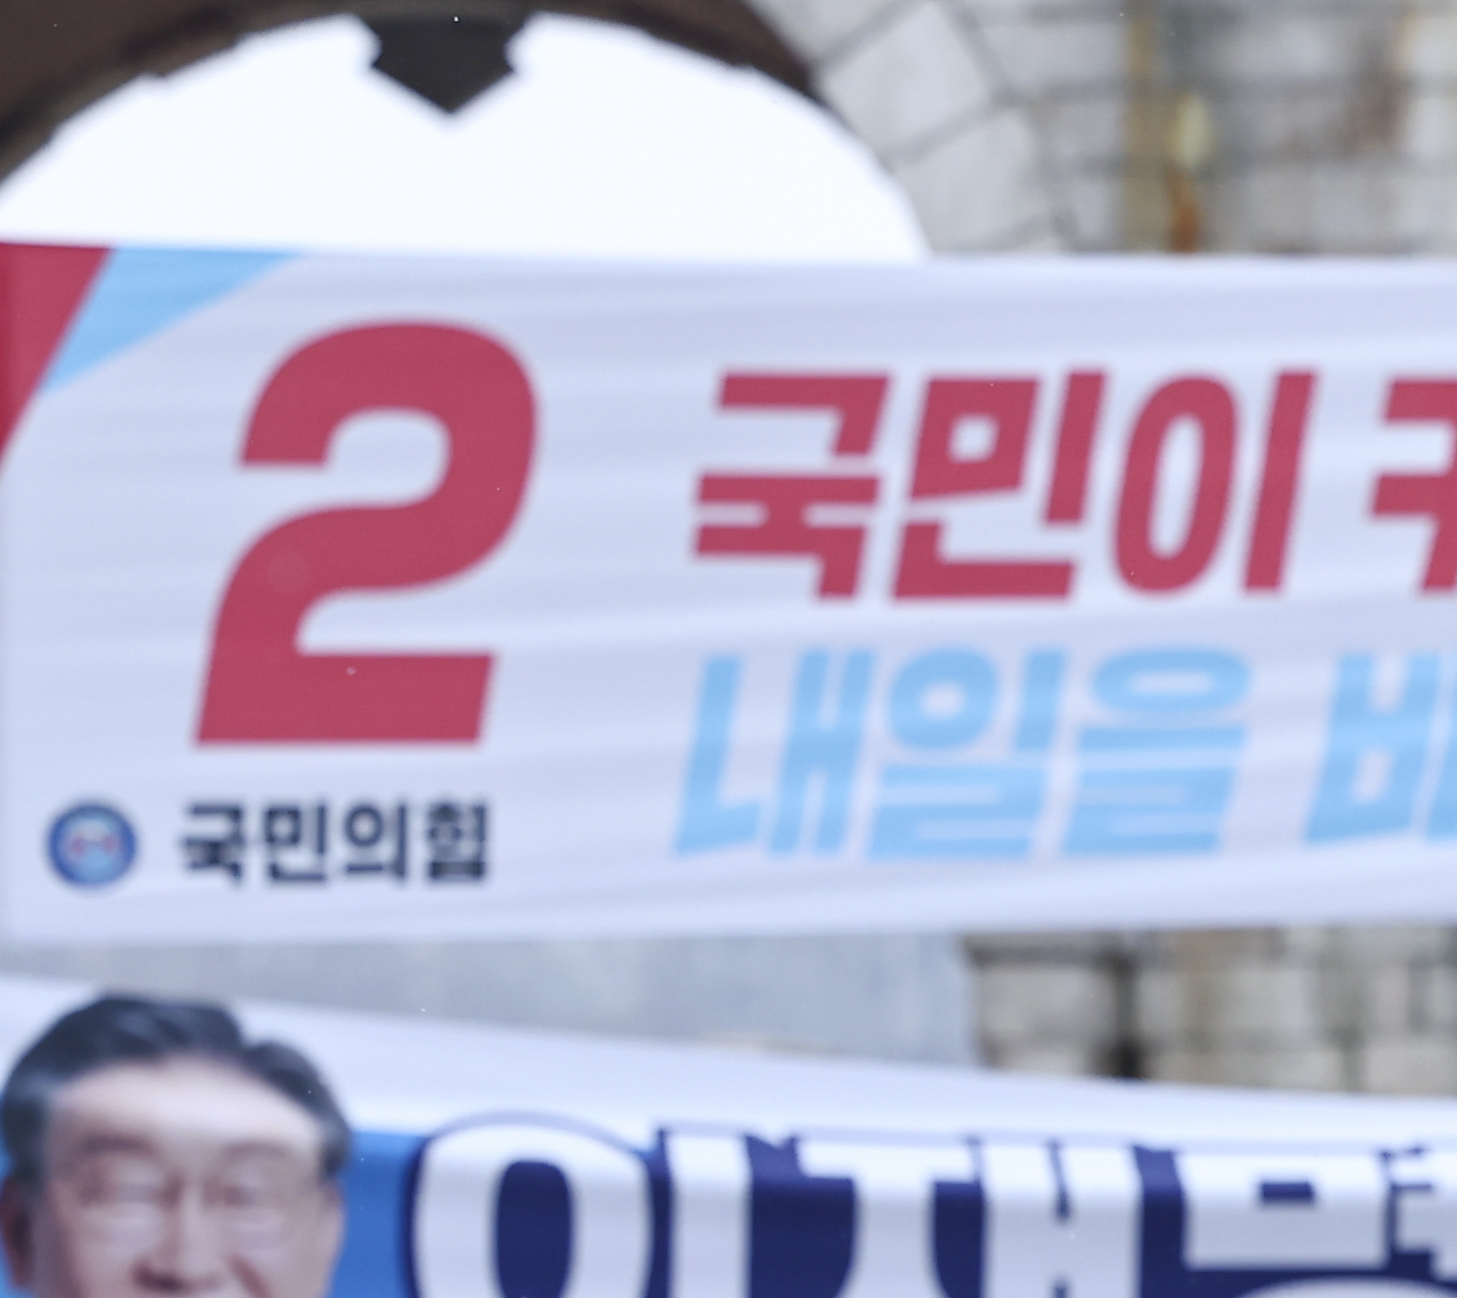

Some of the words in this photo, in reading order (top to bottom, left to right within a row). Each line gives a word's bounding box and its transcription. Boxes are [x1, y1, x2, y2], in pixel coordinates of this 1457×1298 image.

[196, 322, 538, 746] 2
[692, 370, 1316, 602] 국민이
[180, 799, 489, 886] 국민의힘
[671, 644, 1252, 864] 내일을
